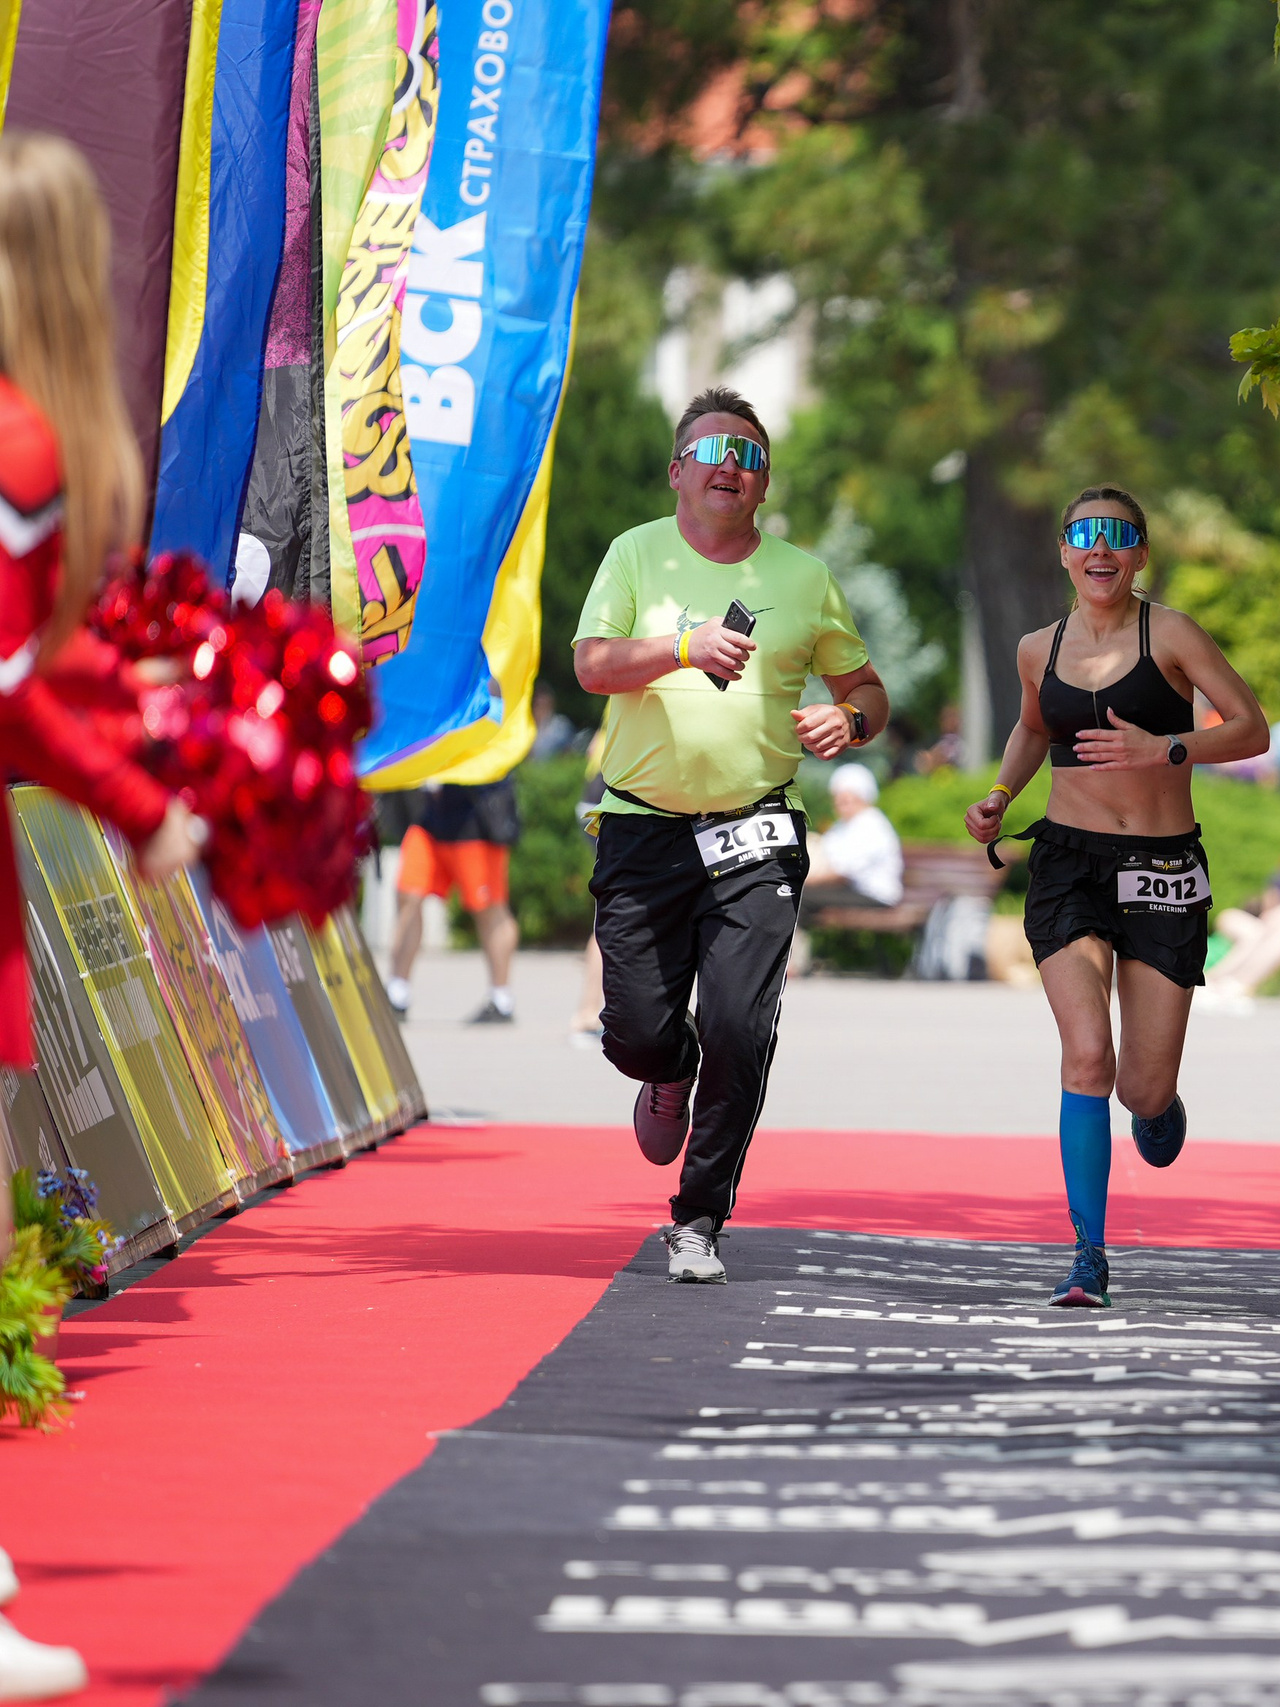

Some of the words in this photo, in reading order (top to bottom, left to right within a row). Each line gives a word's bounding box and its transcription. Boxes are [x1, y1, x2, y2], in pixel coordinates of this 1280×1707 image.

[400, 211, 488, 446] ВСК
[715, 820, 778, 854] 2012
[738, 847, 771, 863] ANATLIY
[1137, 875, 1197, 900] 2012
[1149, 903, 1187, 914] EKATERINA
[774, 1306, 1039, 1324] IRON
